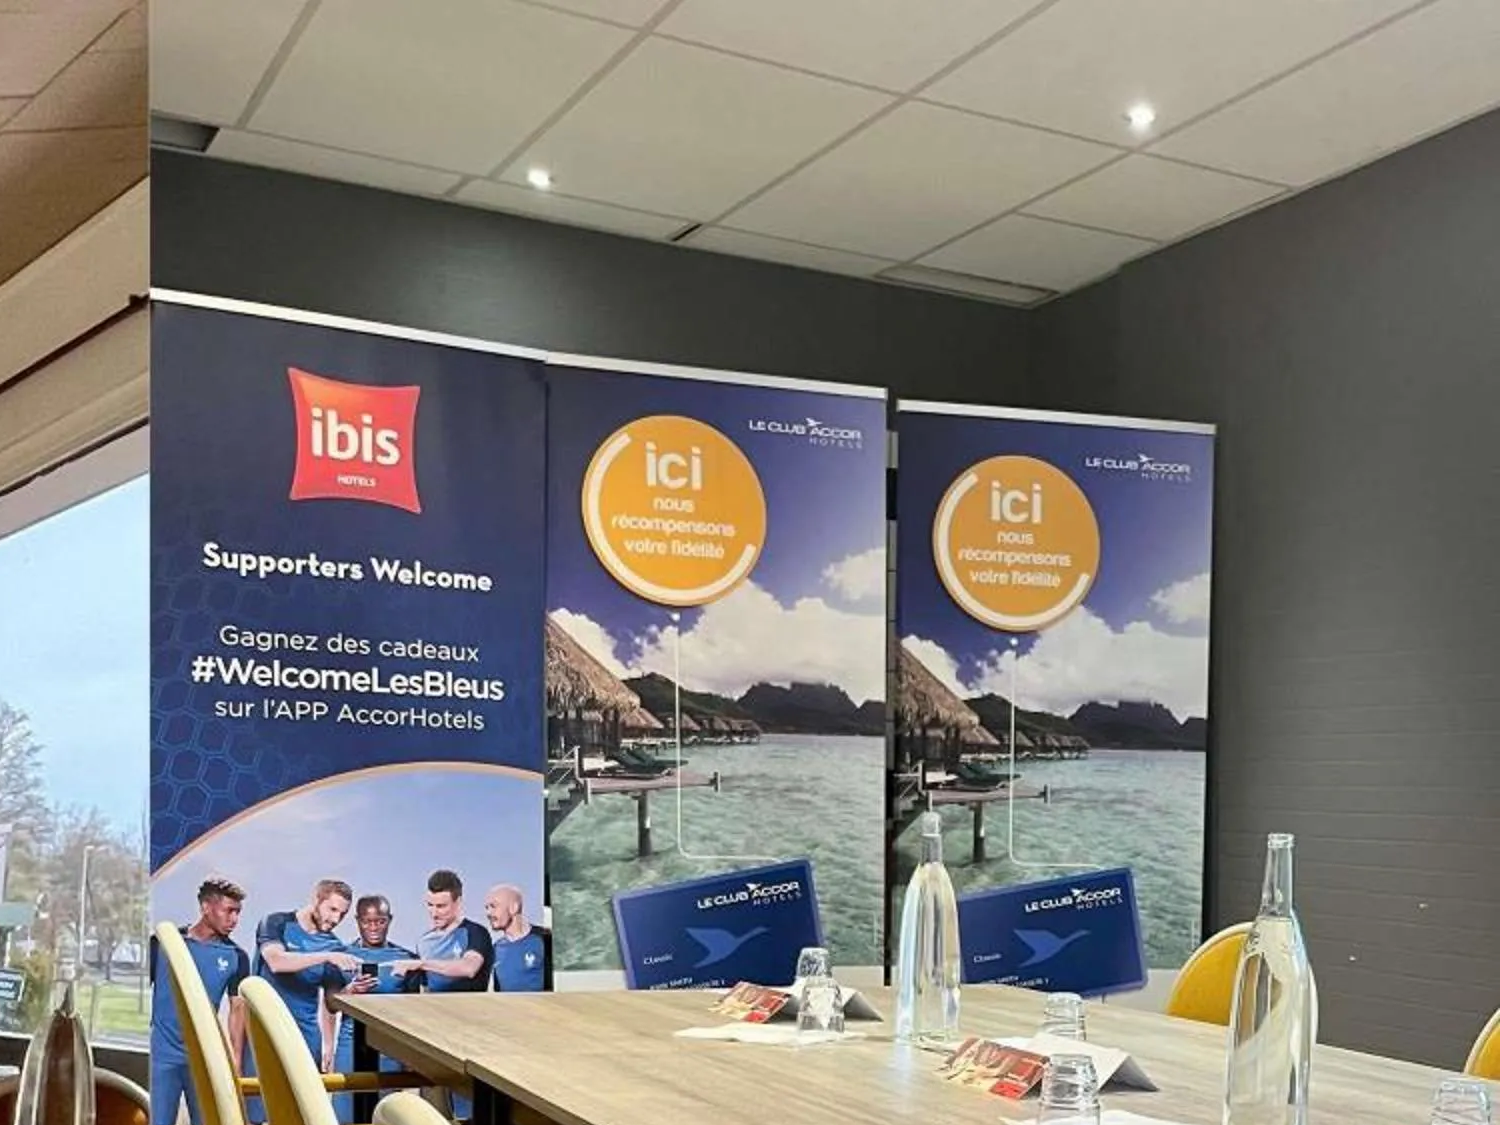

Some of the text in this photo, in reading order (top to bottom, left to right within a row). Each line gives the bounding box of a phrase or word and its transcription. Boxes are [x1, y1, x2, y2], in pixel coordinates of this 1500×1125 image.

[311, 407, 400, 466] ibis
[749, 419, 863, 440] LE CLUB ACCOR
[646, 441, 702, 491] ici
[1085, 457, 1191, 474] LE CLUB ACCOR
[336, 474, 377, 489] HOTELS
[653, 497, 695, 513] nous
[990, 481, 1042, 525] ici
[611, 516, 737, 538] récompensons
[624, 539, 725, 559] votre fidélité
[997, 531, 1034, 546] nous
[202, 542, 493, 592] Supporters Welcome
[958, 548, 1072, 568] récompensons
[969, 570, 1008, 586] votre
[218, 625, 480, 662] Gagnez des cadeaux
[191, 655, 506, 702] #WelcomeLesBleus
[214, 698, 485, 731] sur l'APP AccorHotels
[697, 881, 800, 910] LE CLUB ACCOR
[752, 892, 802, 906] HOTELS
[1025, 888, 1121, 913] LE CLUB ACCOR
